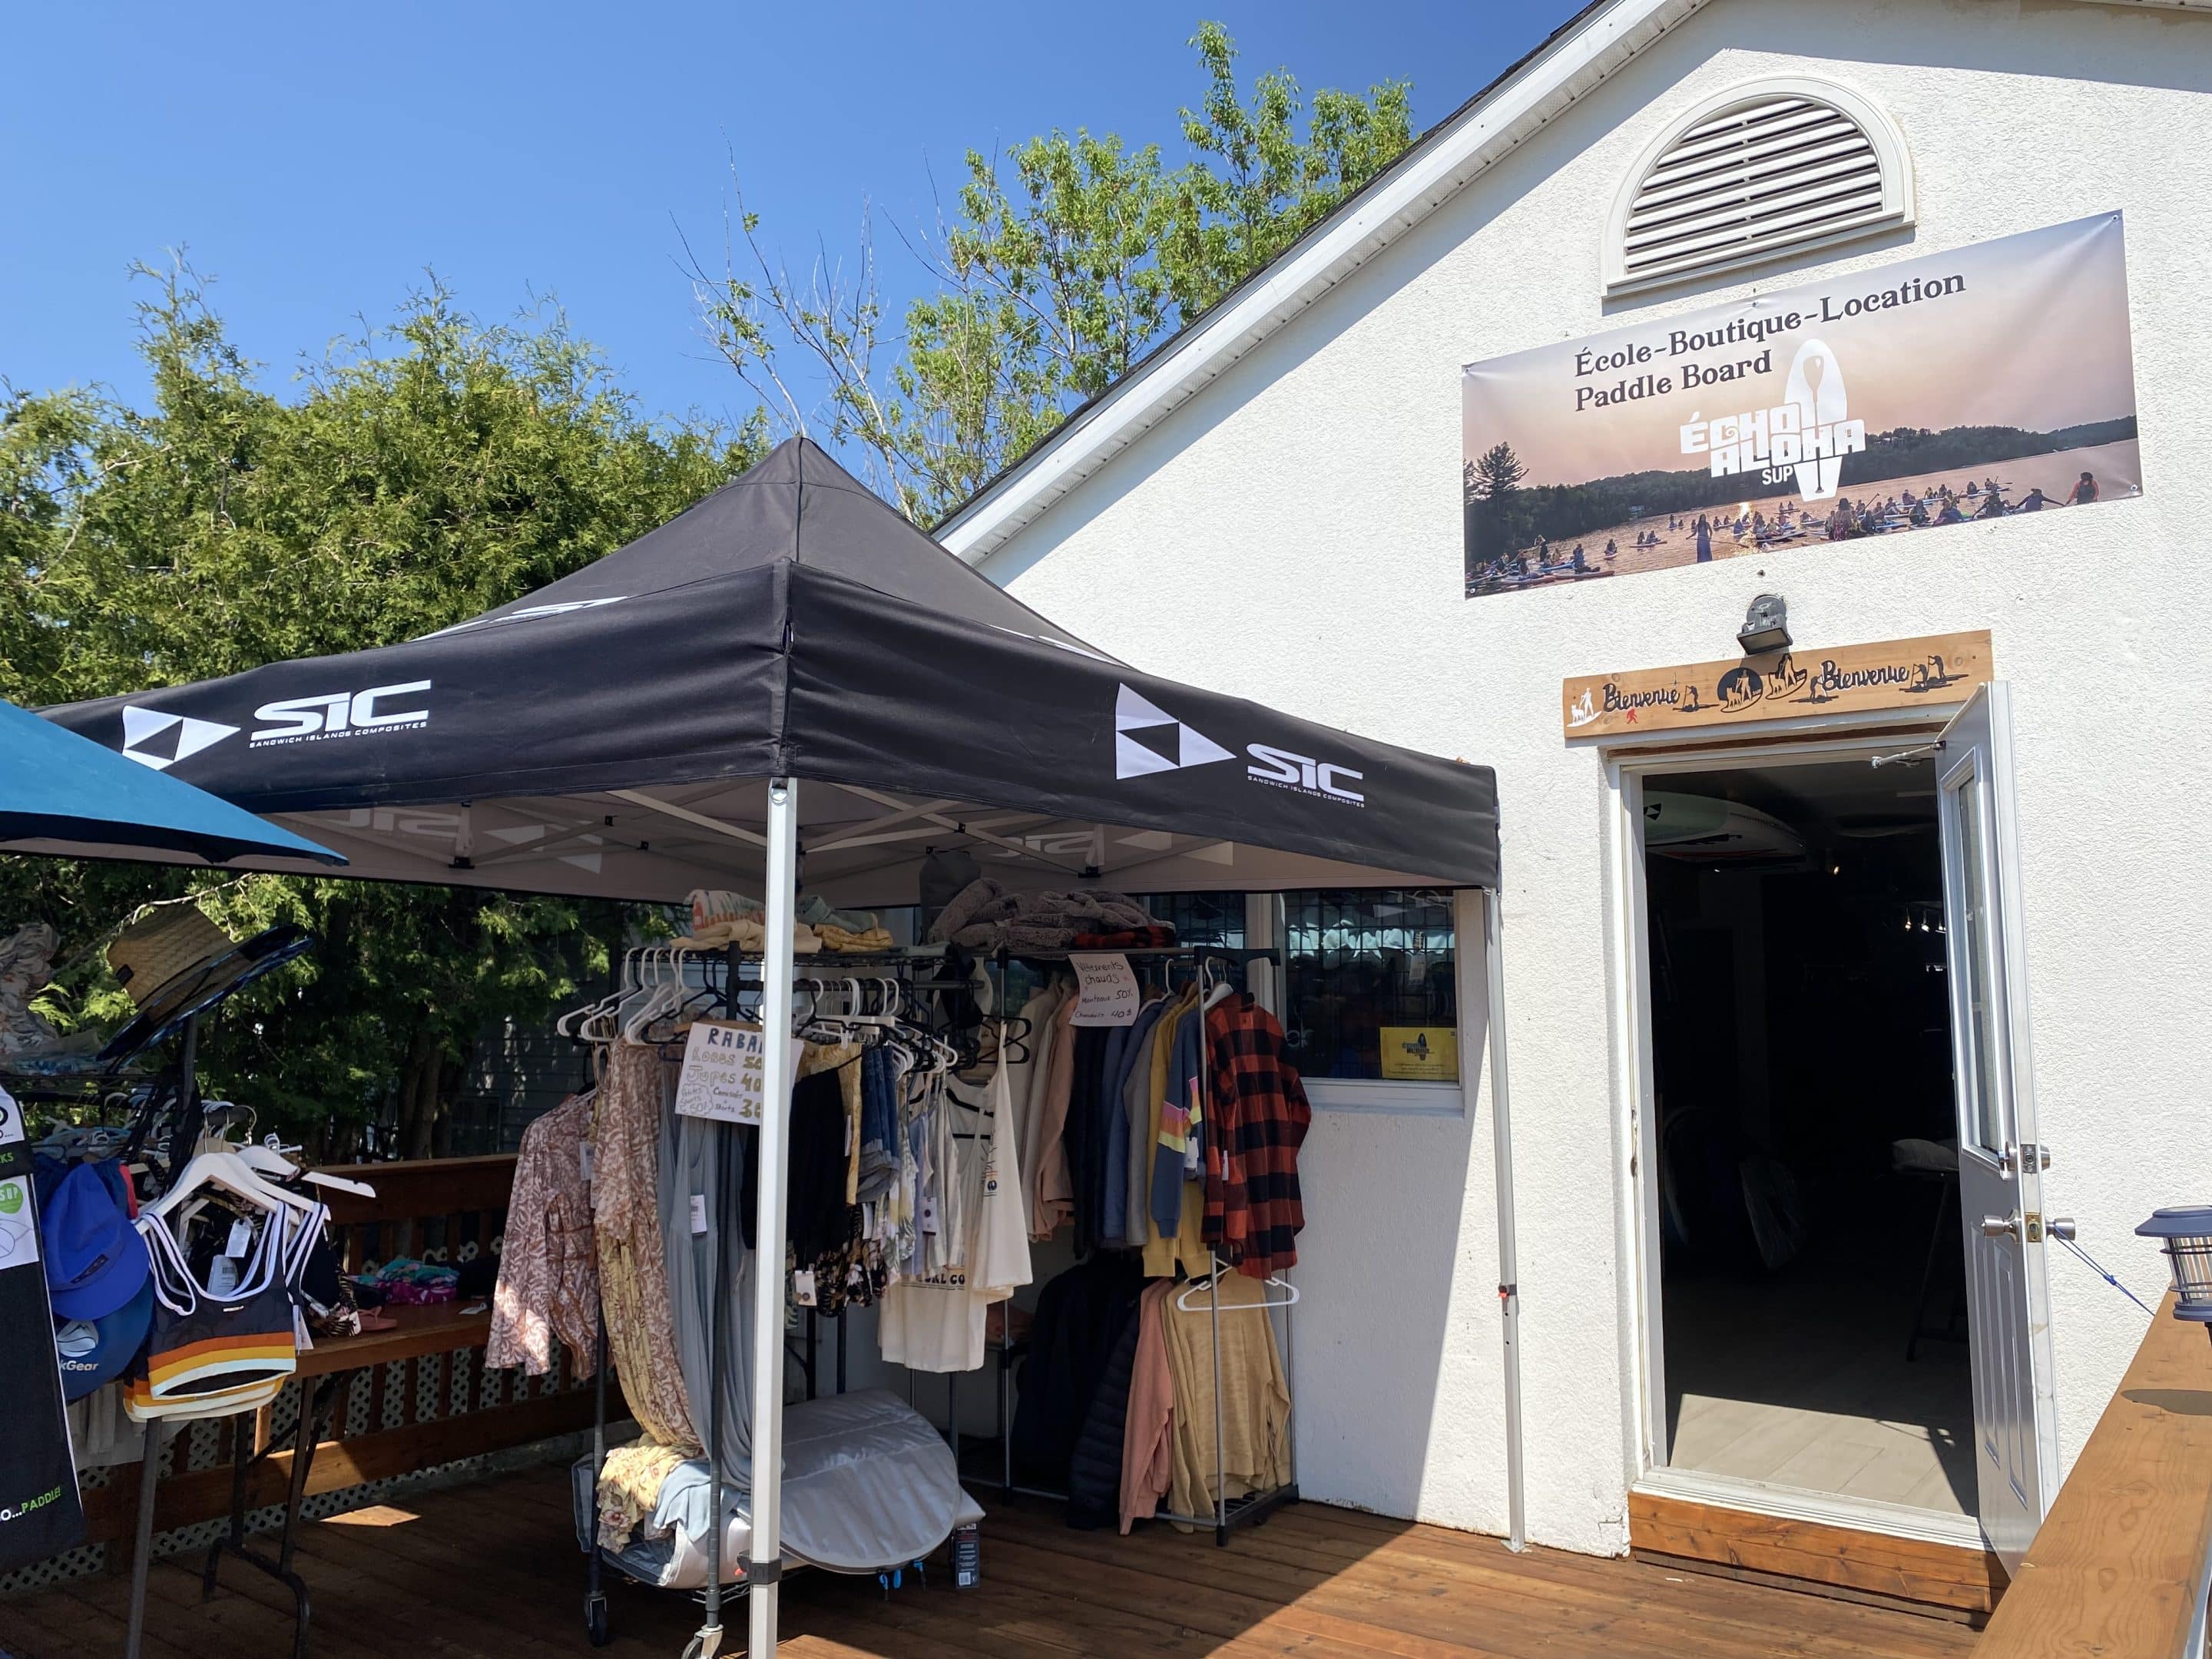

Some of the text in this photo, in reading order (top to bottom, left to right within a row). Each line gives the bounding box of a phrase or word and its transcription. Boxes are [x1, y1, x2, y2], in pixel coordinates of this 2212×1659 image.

[1575, 349, 1773, 412] Paddle Board
[1680, 402, 1802, 454] ÉCHO
[1710, 419, 1866, 478] ALOHA
[1762, 464, 1793, 485] SUP
[1821, 660, 1909, 691] Bienvenue
[1603, 683, 1681, 713] Bienvenue
[249, 721, 427, 749] SANDWICH ISLANDS COMPOSITES
[1247, 775, 1365, 808] SANDWICH ISLANDS COMPOSITES
[60, 1360, 98, 1372] kGear
